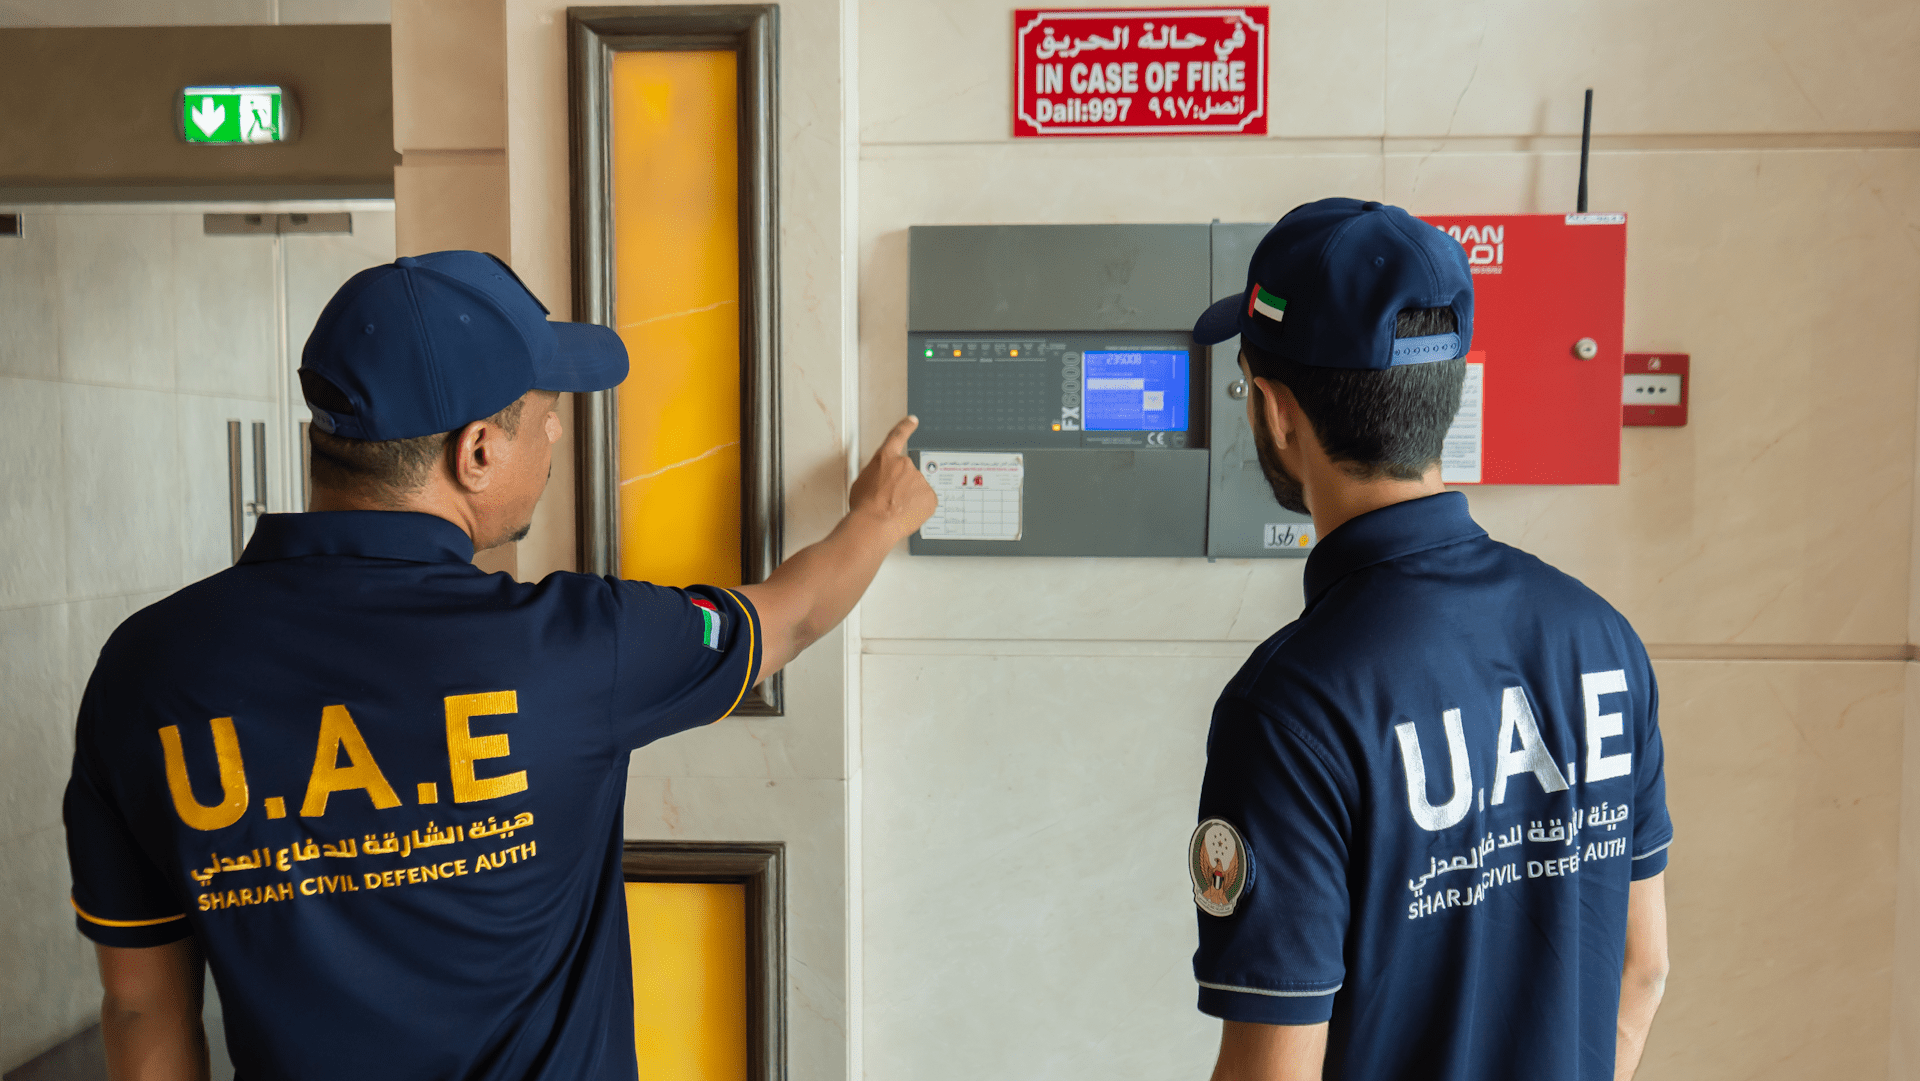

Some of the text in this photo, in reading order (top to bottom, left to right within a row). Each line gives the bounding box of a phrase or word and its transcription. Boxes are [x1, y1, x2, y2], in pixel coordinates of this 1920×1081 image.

[1036, 22, 1246, 61] في حالة الحريق
[1036, 61, 1246, 94] IN CASE OF FIRE
[1036, 97, 1132, 123] Dail:997
[1061, 351, 1081, 431] FX6000
[158, 690, 529, 831] U.A.E
[191, 811, 534, 887] هيئة الشارقة للدفاع المدني
[1587, 801, 1629, 831] هيئة
[198, 841, 537, 912] SHARJAH CIVIL DEFENCE AUTH
[1408, 883, 1485, 919] SHARJA
[1584, 837, 1627, 862] AUTH
